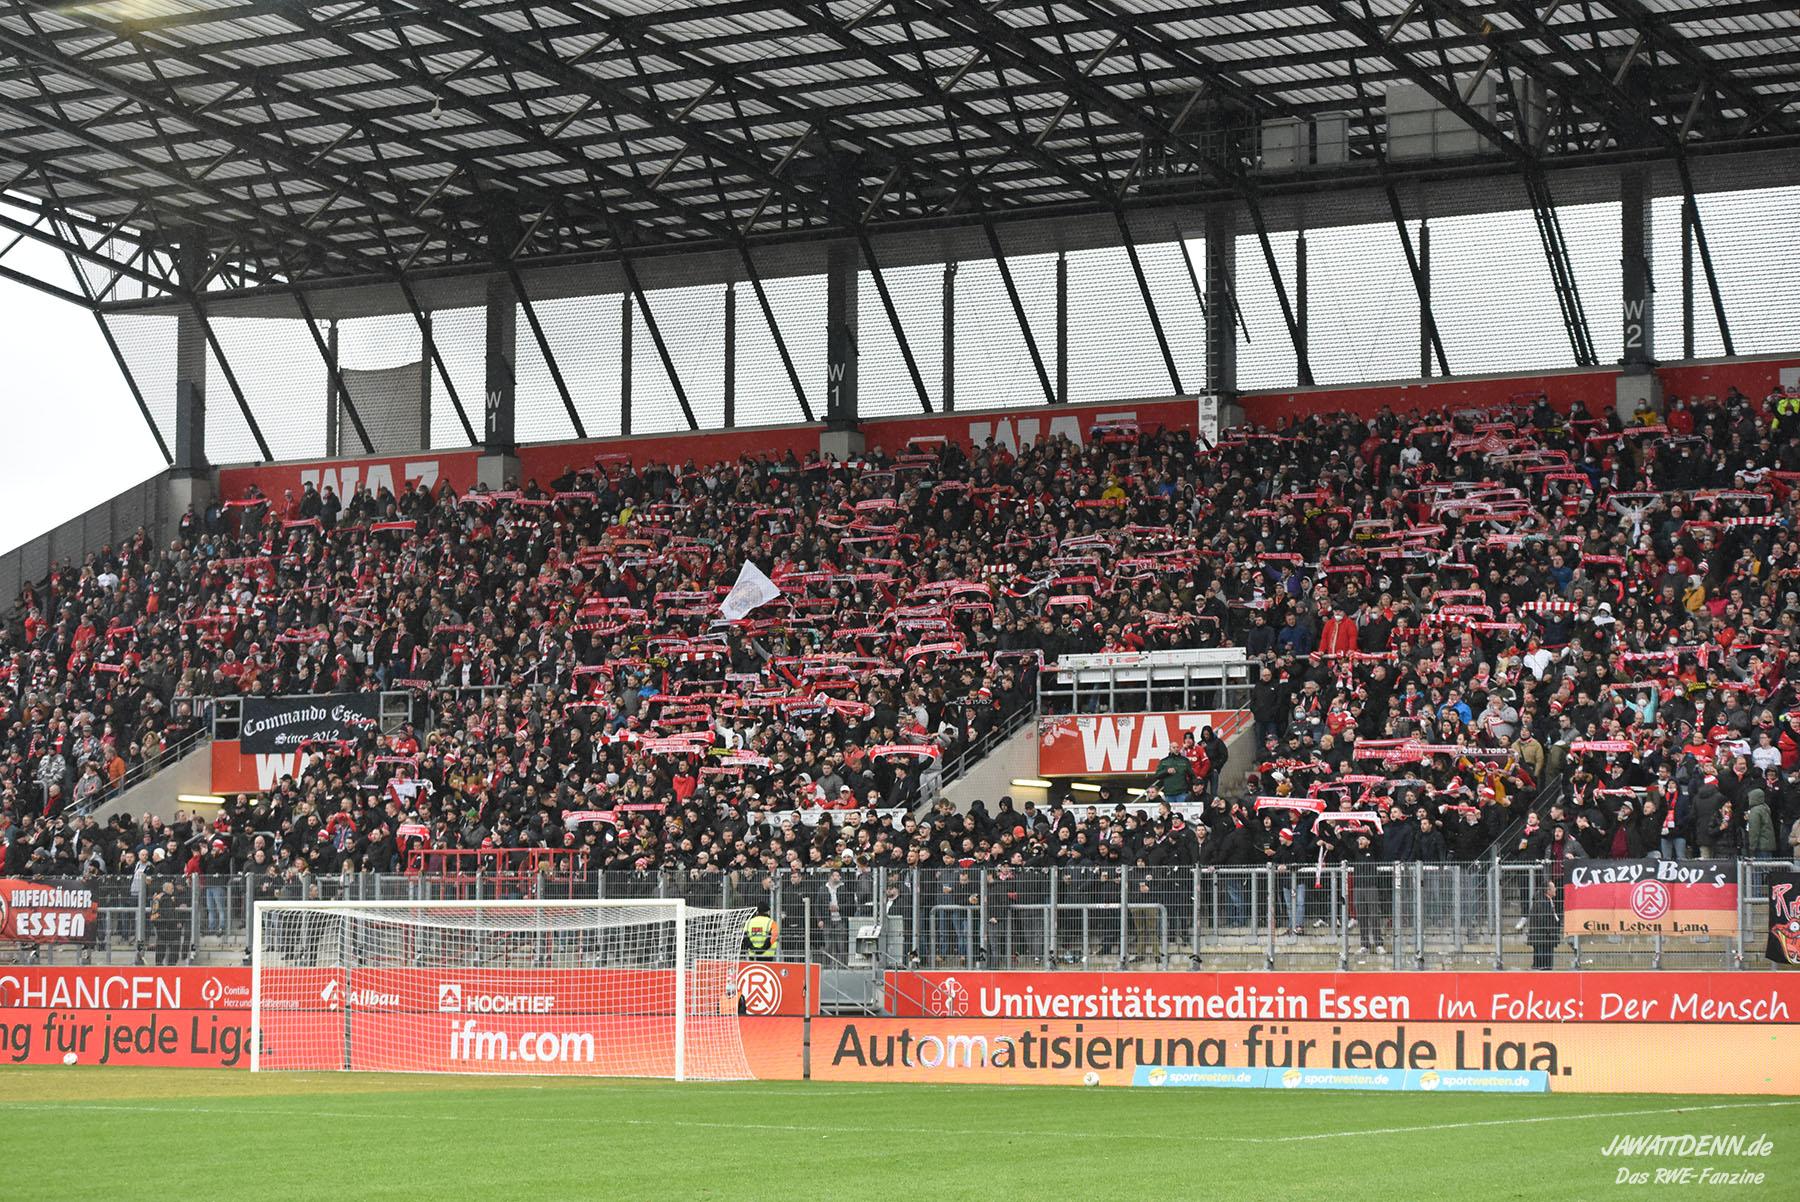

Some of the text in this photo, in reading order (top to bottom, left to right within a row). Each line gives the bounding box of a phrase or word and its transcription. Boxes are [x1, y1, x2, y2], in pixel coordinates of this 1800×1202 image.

[1624, 299, 1643, 320] W
[1626, 324, 1642, 348] 2
[828, 363, 845, 381] W
[486, 391, 501, 408] W
[831, 387, 840, 406] 1
[488, 412, 497, 431] 1
[969, 412, 1136, 461] WA
[301, 461, 439, 520] WAZ
[244, 705, 327, 736] Commando
[11, 886, 92, 908] HAFENSÄNGER
[16, 912, 86, 937] ESSEN
[349, 990, 400, 1006] Allbau
[466, 995, 555, 1013] HOCHTIEF
[980, 986, 1790, 1022] Universitätsmedizin Essen Im Fokus: Der Mensch
[43, 1012, 93, 1052] für
[100, 1014, 178, 1063] jede
[450, 1020, 595, 1062] ifm.com
[832, 1024, 1573, 1076] Automatisierung für jede Liga.
[1170, 1072, 1252, 1083] sportwetten.de
[1304, 1074, 1389, 1085] sportwetten.de
[1443, 1076, 1529, 1087] sportwetten.de
